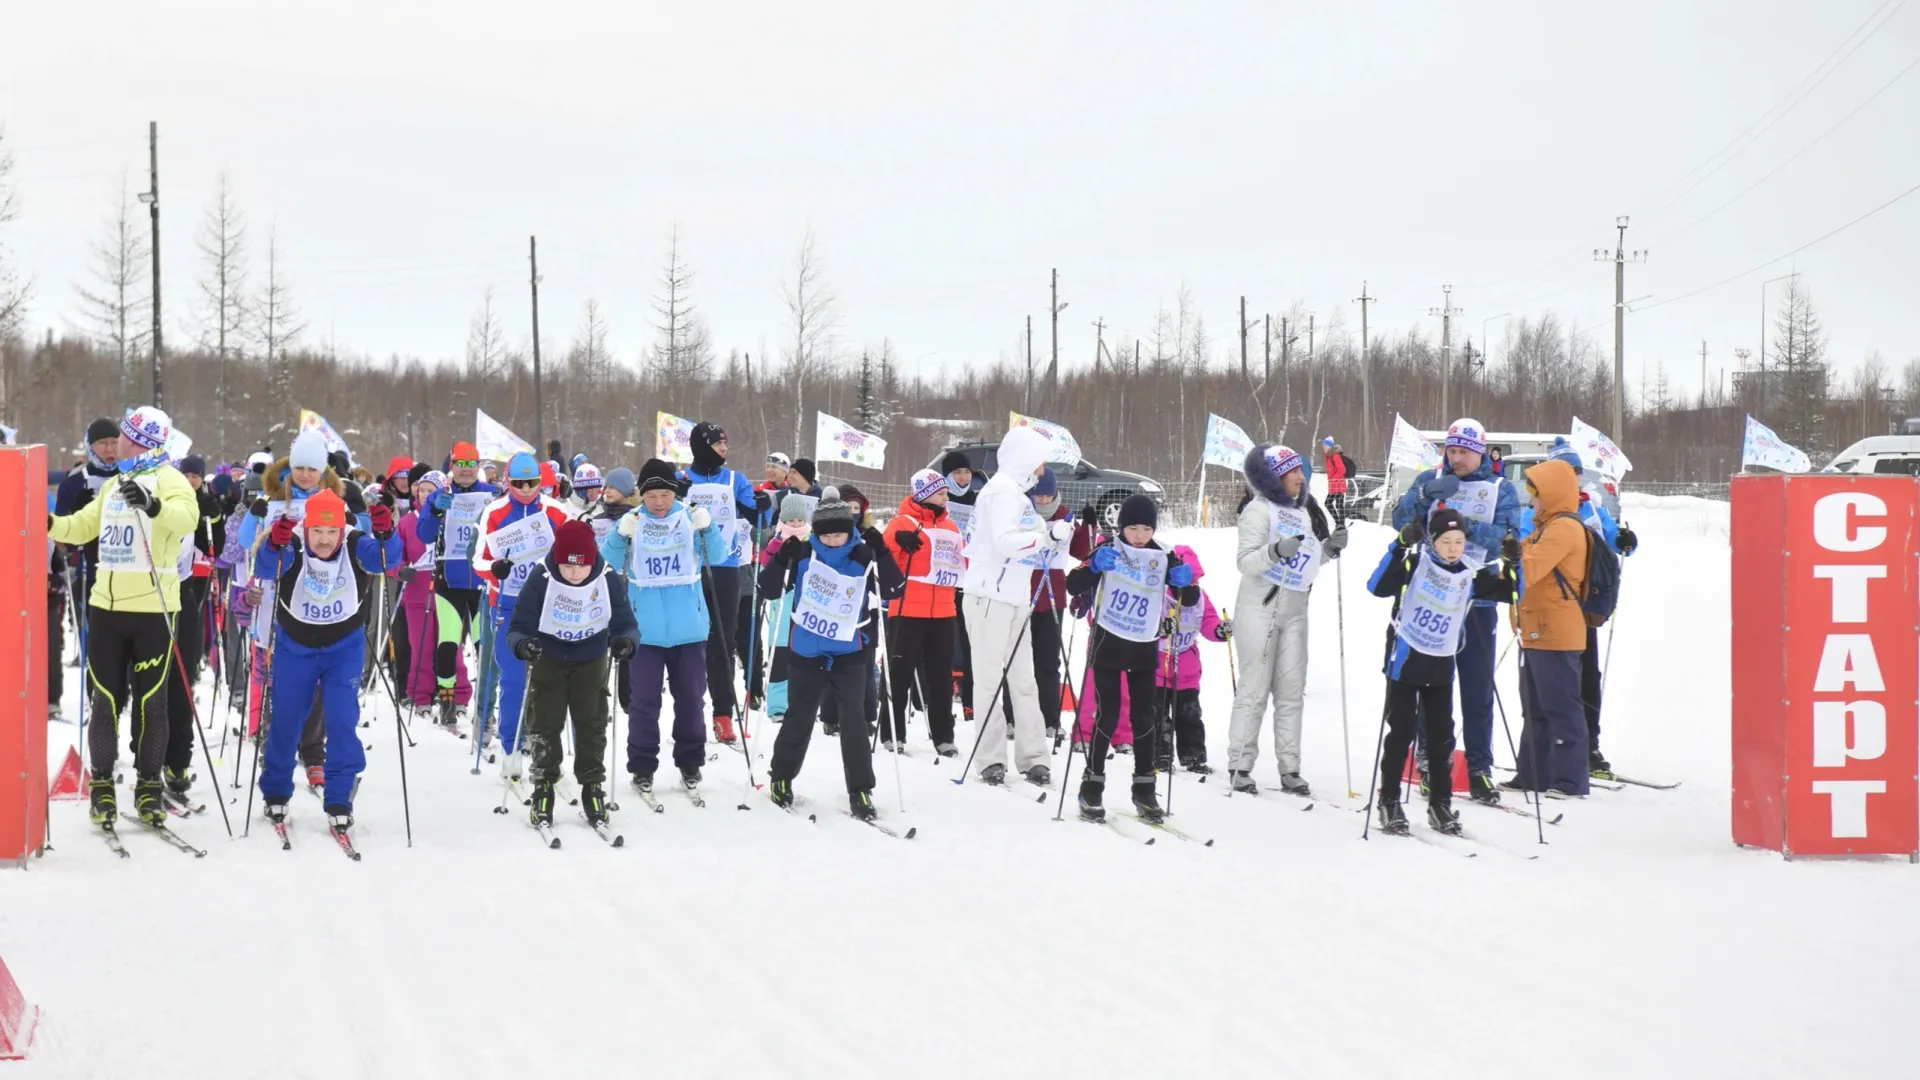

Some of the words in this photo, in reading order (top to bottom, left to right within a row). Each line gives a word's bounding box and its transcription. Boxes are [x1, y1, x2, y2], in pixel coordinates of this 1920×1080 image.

[645, 553, 681, 576] 1874
[807, 578, 834, 597] РОССИИ
[810, 573, 838, 590] ЛЫЖНЯ
[555, 594, 583, 607] ЛЫЖНЯ
[805, 587, 831, 606] 2022
[1110, 588, 1149, 618] 1978
[302, 599, 343, 619] 1980
[552, 608, 581, 623] 2022
[554, 600, 583, 613] РОССИИ
[802, 611, 839, 639] 1908
[1412, 605, 1452, 635] 1856
[555, 627, 595, 641] 1946
